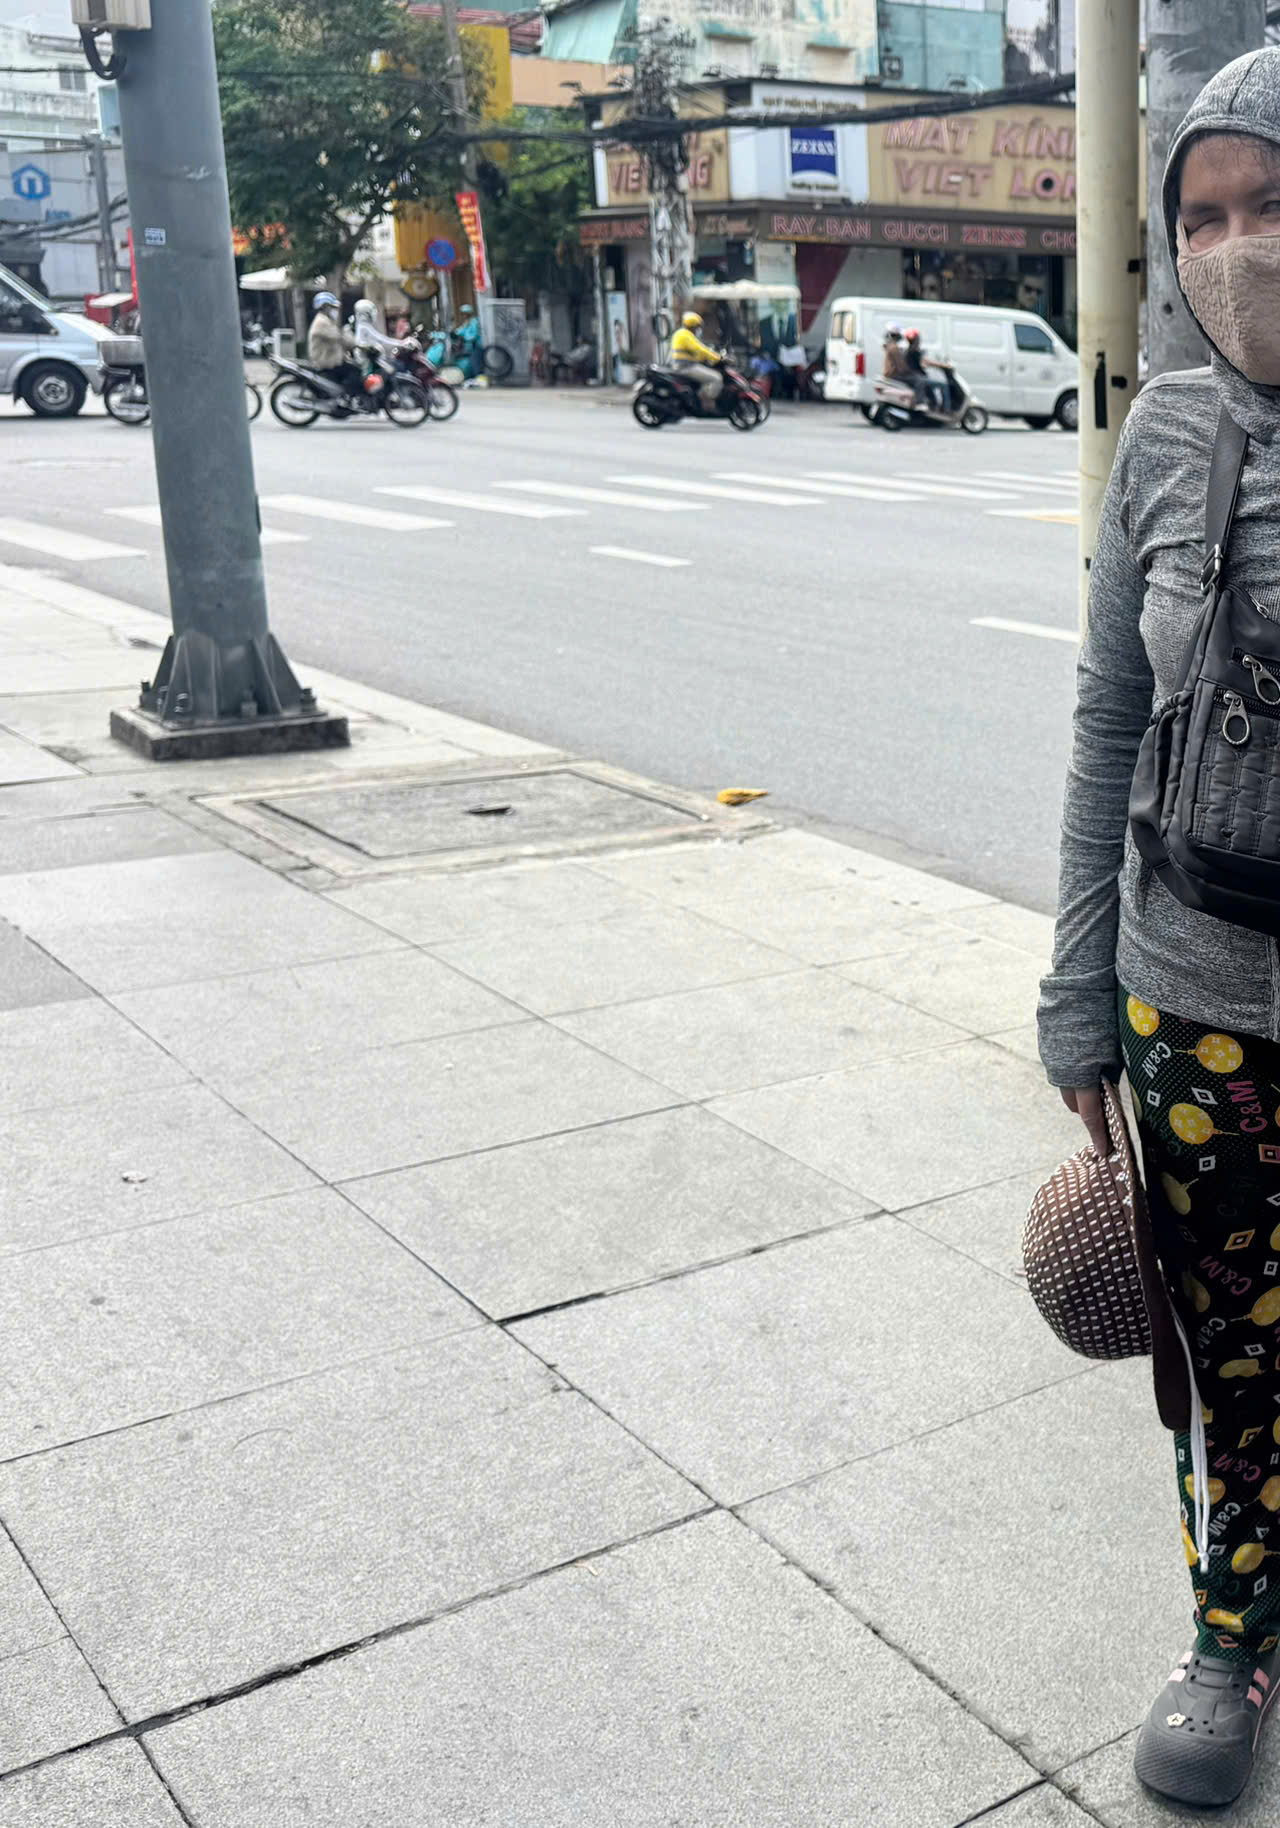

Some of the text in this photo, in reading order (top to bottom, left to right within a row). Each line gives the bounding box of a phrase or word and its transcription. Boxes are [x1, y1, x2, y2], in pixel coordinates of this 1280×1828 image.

[992, 116, 1076, 159] KÍN
[1010, 168, 1076, 200] LO
[882, 222, 949, 241] GUCCI
[1142, 1042, 1172, 1080] C&M
[1226, 1080, 1268, 1133] C&M
[1199, 1256, 1252, 1296] C&M
[1214, 1453, 1262, 1483] C&M
[1208, 1502, 1242, 1537] C&M
